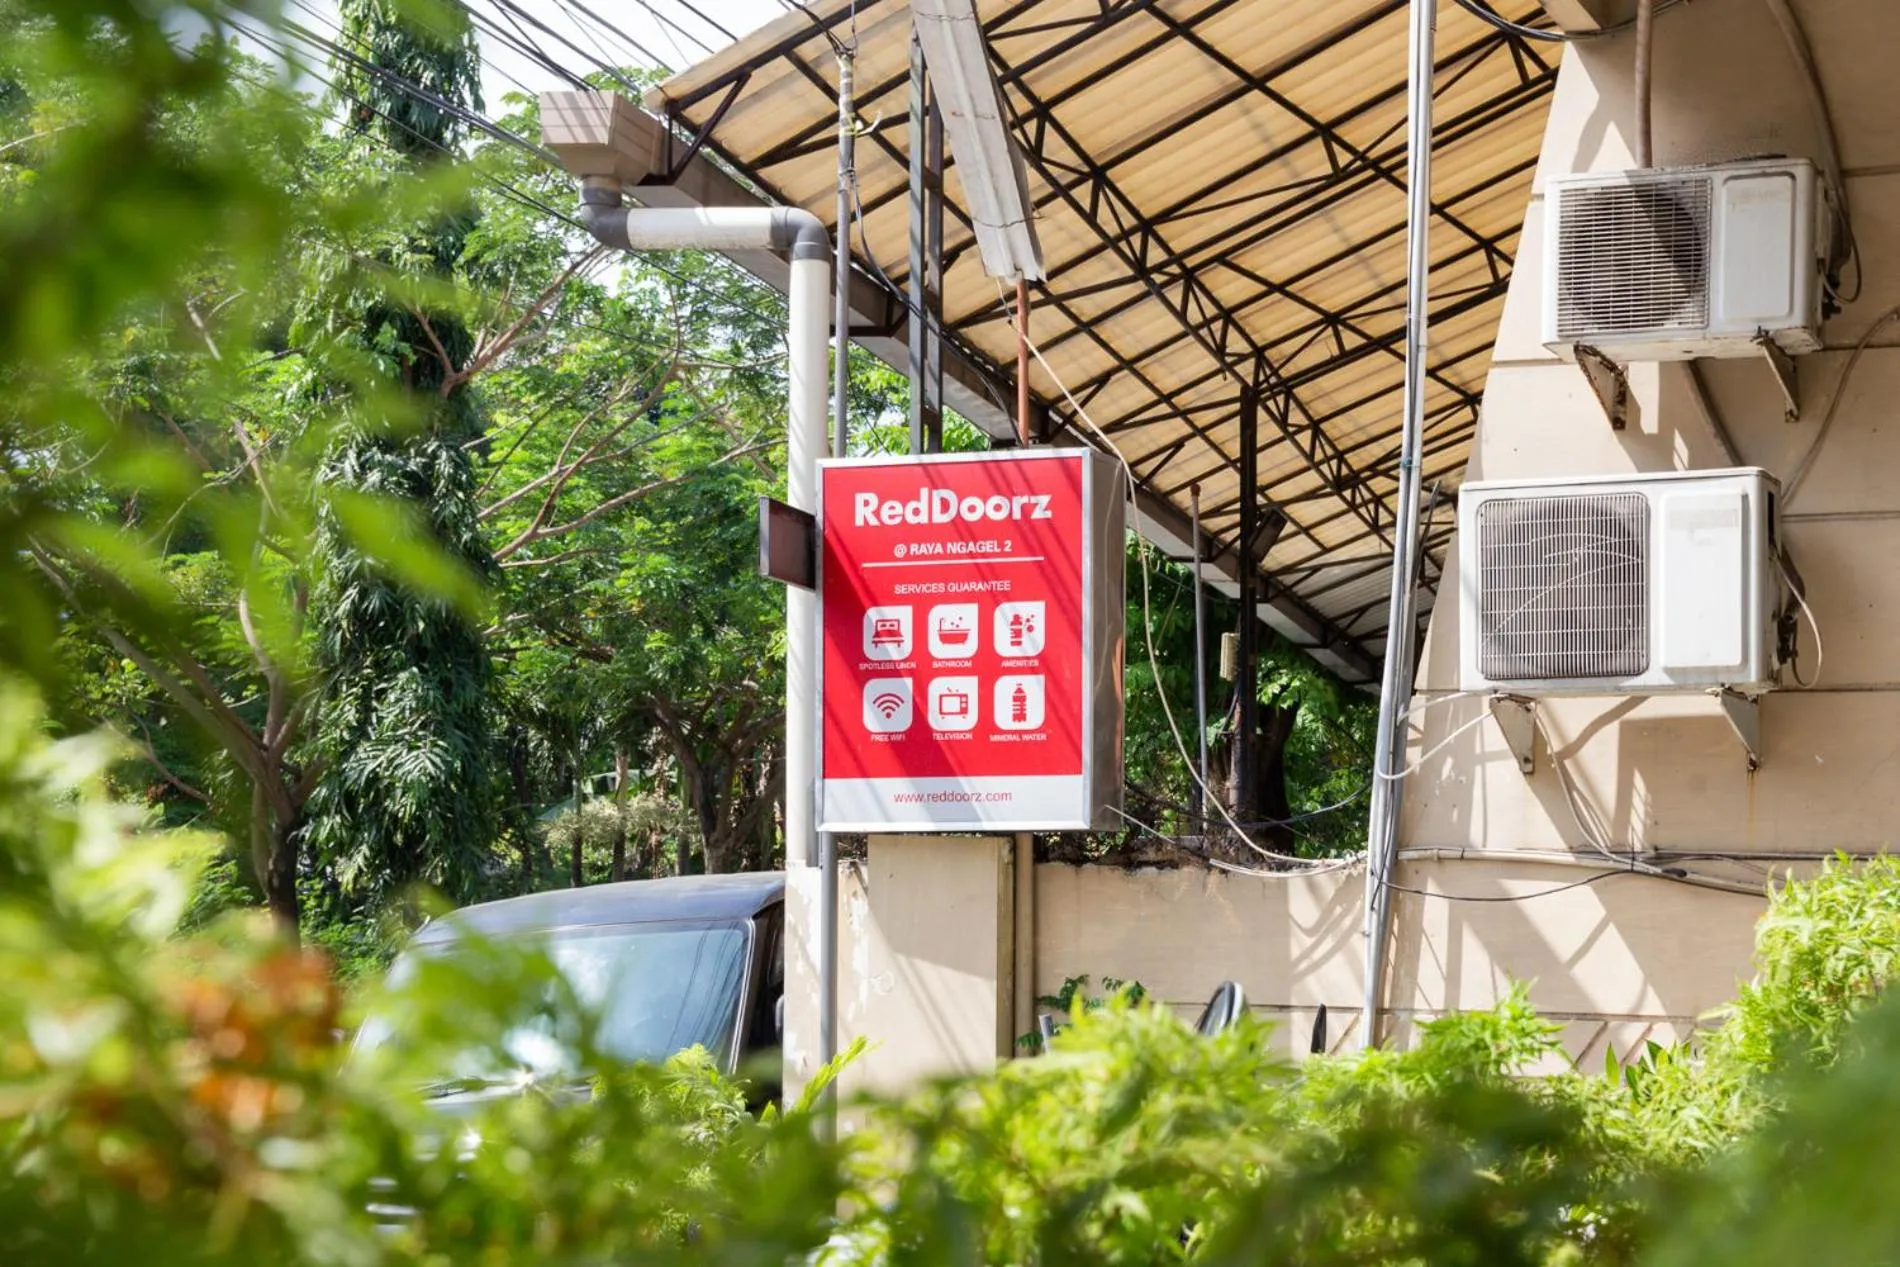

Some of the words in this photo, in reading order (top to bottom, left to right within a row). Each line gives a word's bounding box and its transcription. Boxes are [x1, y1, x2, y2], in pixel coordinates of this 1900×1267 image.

[855, 487, 1052, 526] RedDoorz
[894, 544, 907, 558] @
[910, 543, 943, 556] RAYA
[947, 540, 1001, 554] NGAGEL
[1004, 540, 1012, 552] 2
[894, 582, 946, 595] SERVICES
[947, 580, 1011, 593] GUARANTEE
[932, 660, 973, 668] BATHROOM
[1001, 659, 1039, 667] AMENITIES
[871, 733, 889, 741] FREE
[933, 732, 973, 740] TELEVISION
[989, 733, 1021, 742] MINERAL
[1021, 732, 1047, 741] WATER
[893, 789, 1013, 803] www.reddoorz.com
